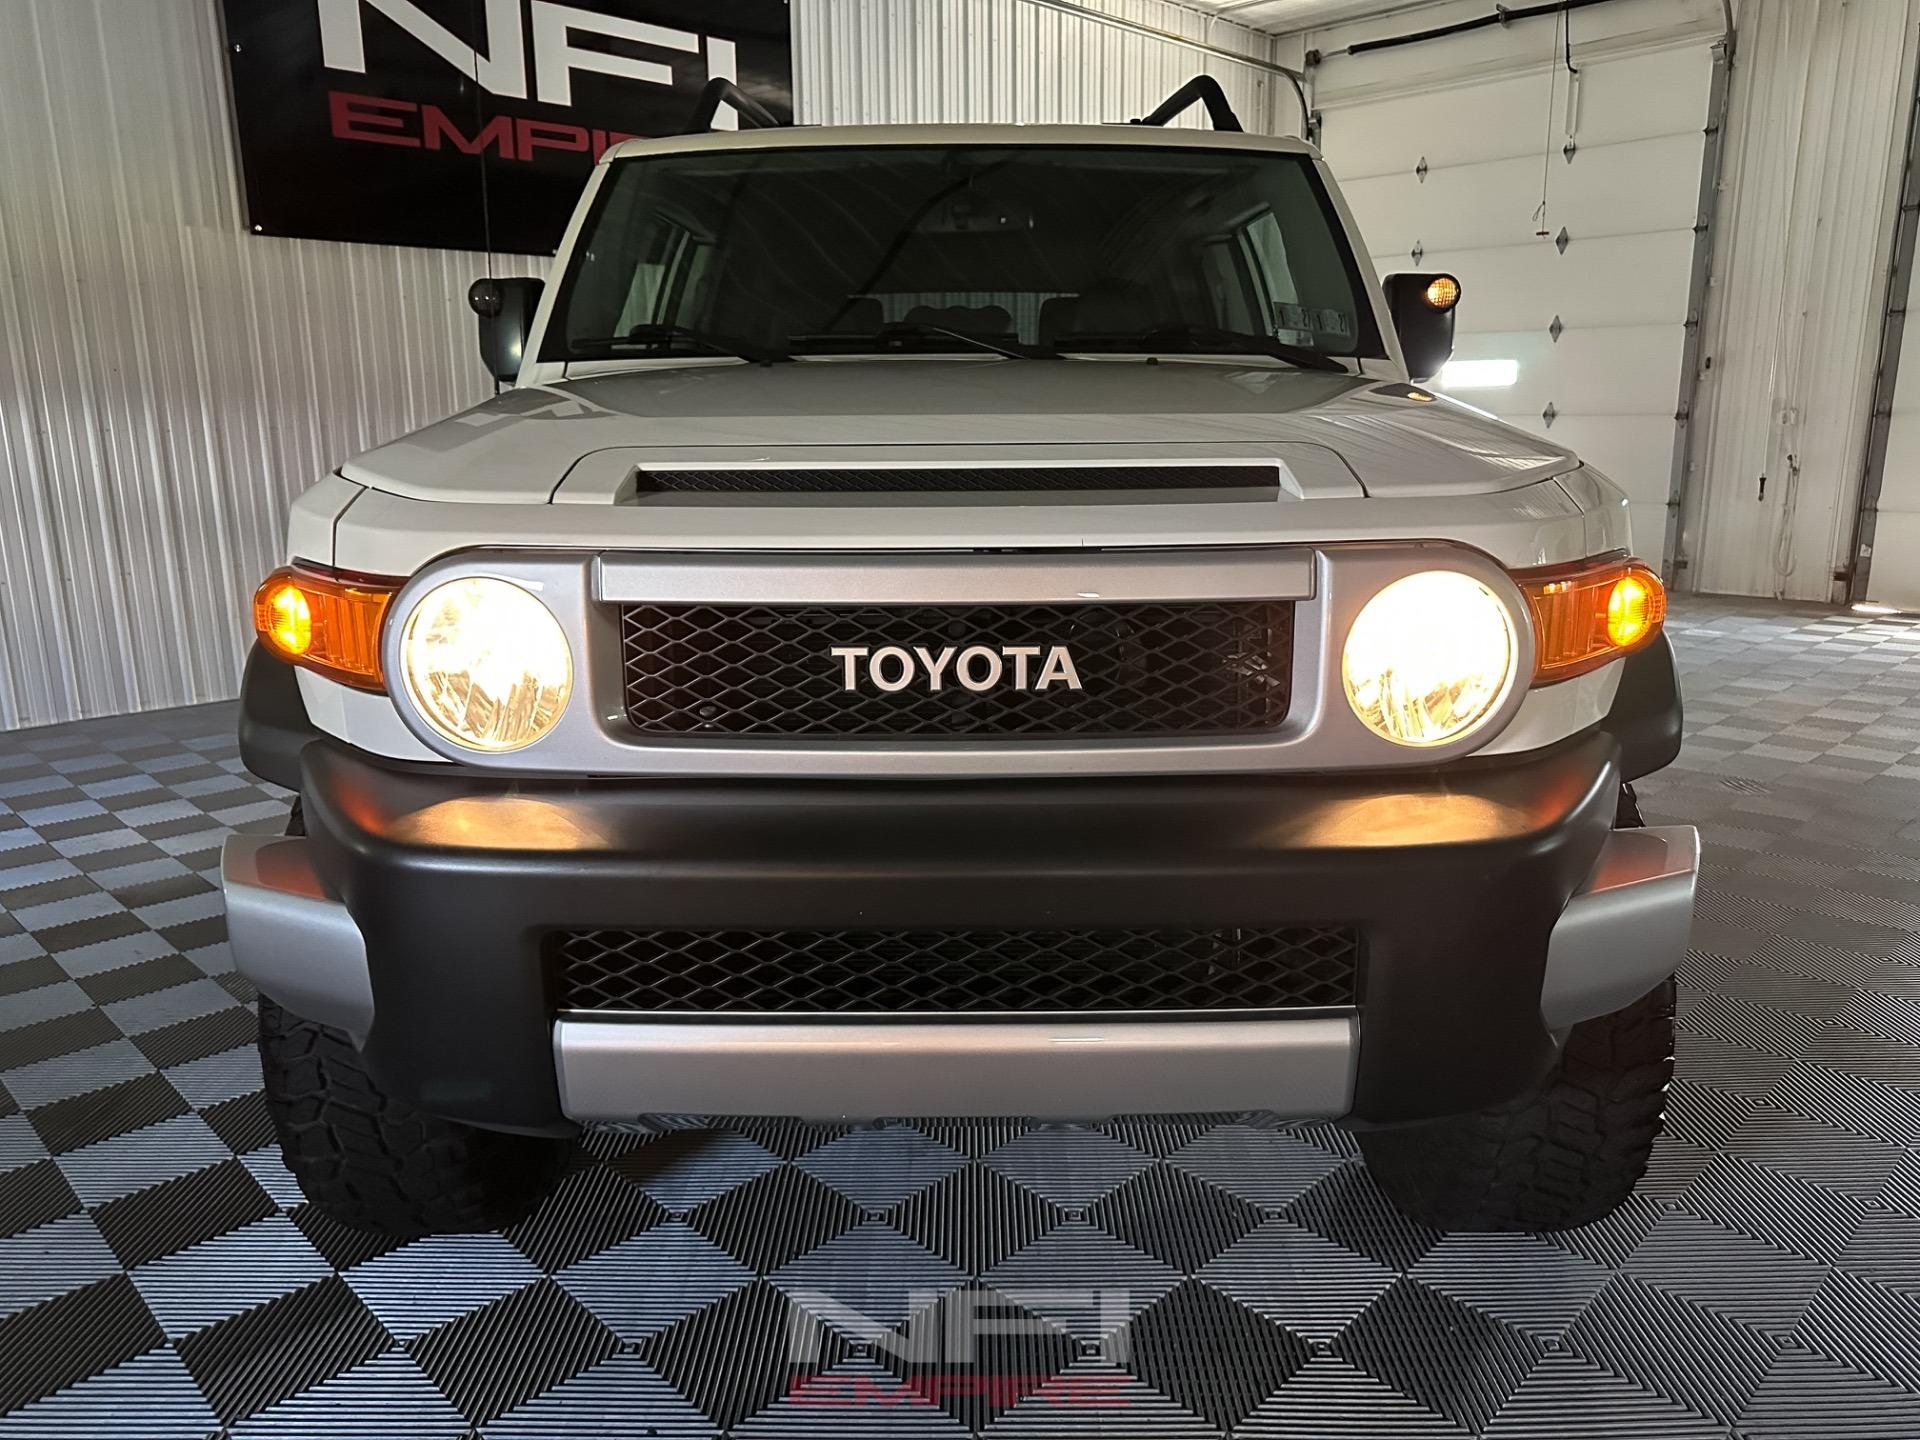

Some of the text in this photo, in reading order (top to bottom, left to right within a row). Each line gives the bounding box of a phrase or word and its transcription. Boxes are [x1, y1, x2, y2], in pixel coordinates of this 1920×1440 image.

[318, 0, 739, 131] NFI
[329, 91, 643, 167] EMPI
[831, 645, 1083, 692] TOYOTA
